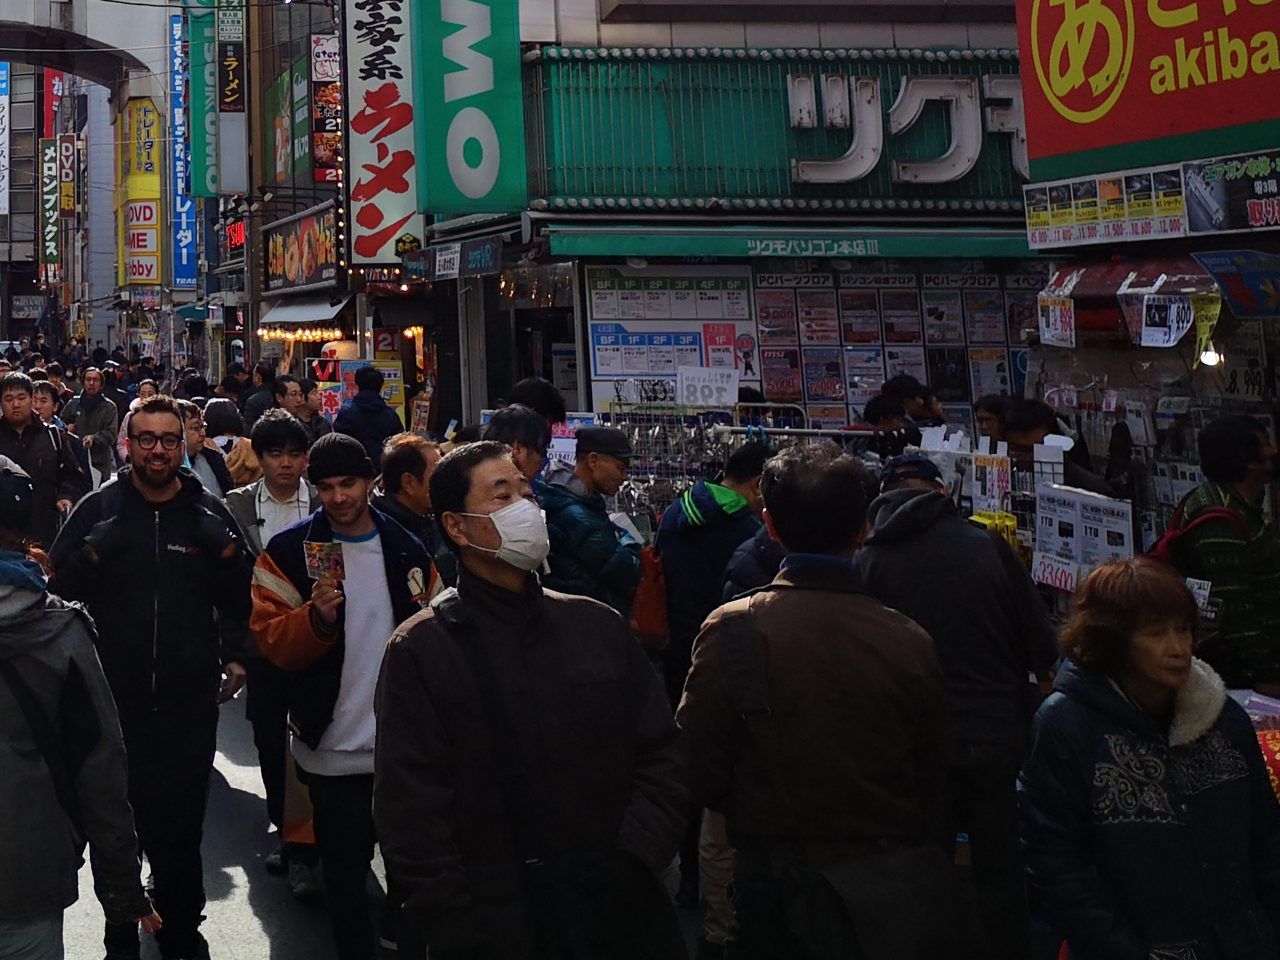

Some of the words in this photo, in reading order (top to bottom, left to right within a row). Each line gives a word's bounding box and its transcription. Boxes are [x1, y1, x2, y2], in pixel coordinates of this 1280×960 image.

[223, 57, 240, 102] ラーメン
[43, 145, 58, 256] メロンブックス
[652, 336, 668, 345] 2F
[679, 335, 694, 344] 3F
